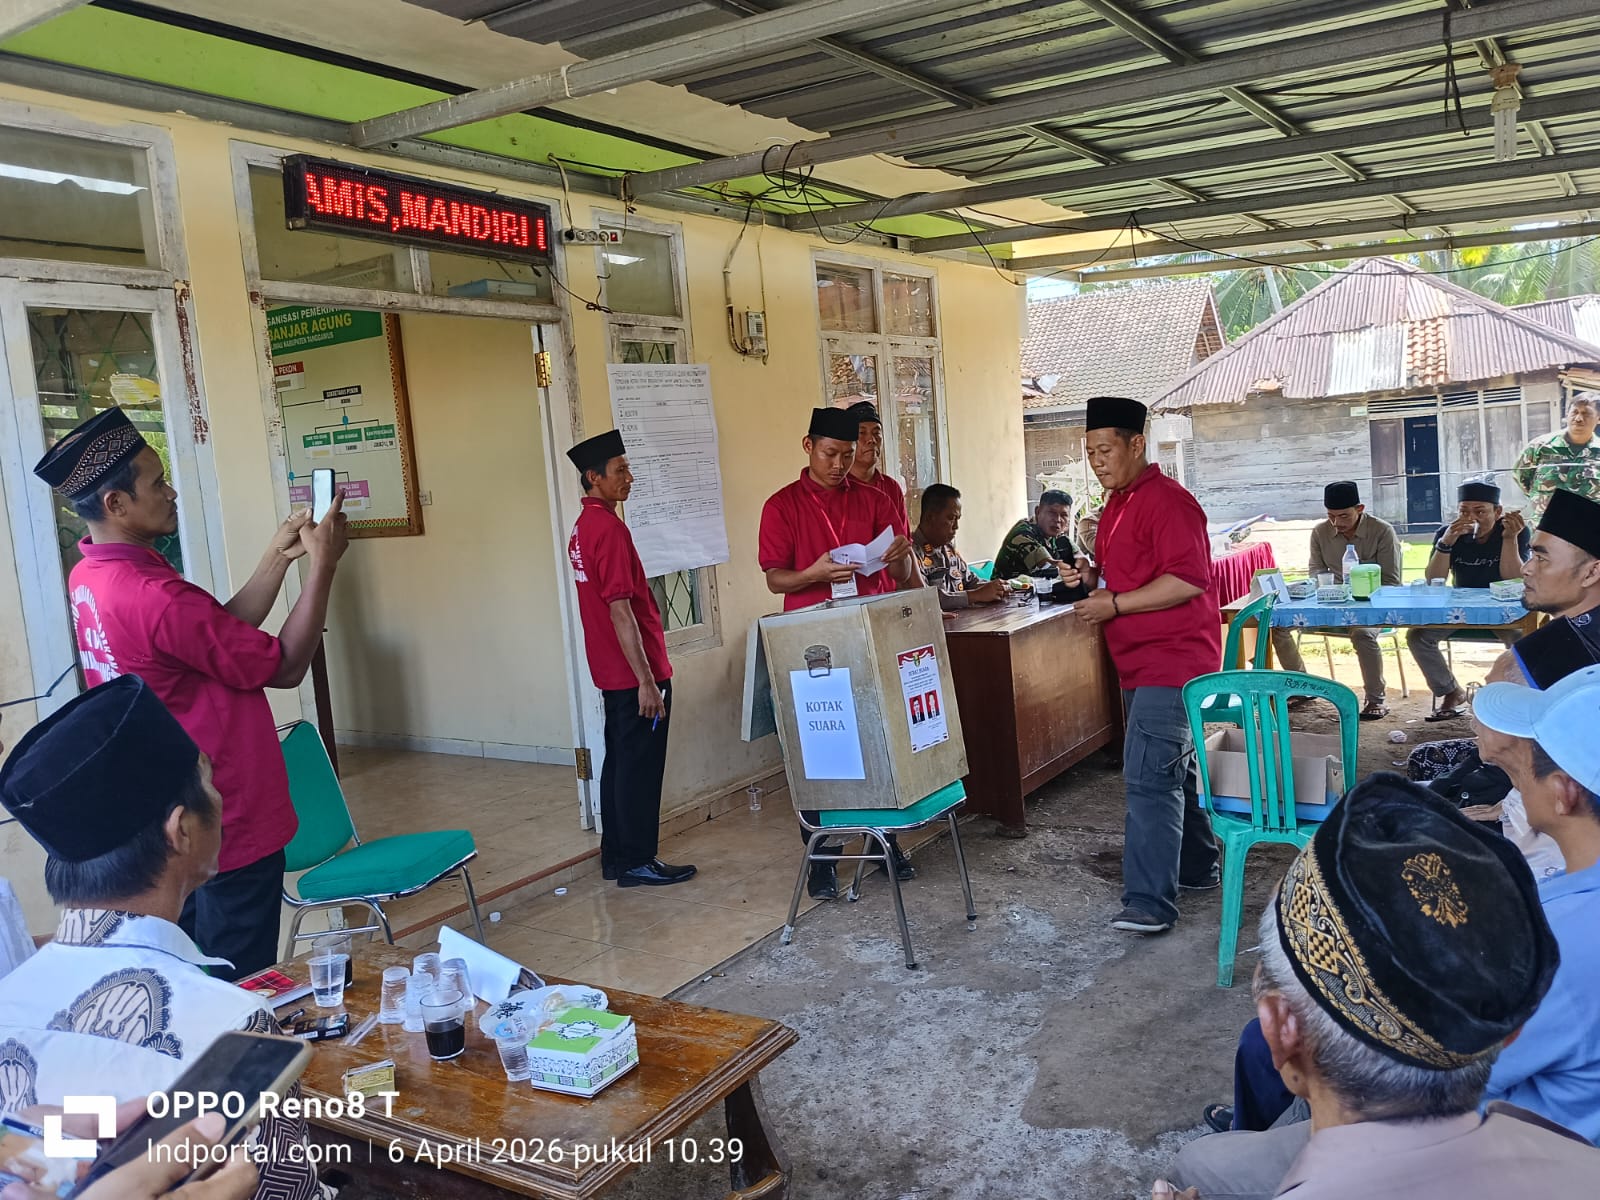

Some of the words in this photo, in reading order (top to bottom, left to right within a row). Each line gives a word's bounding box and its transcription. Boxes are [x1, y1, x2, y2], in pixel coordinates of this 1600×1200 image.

[312, 313, 352, 332] AGUNG
[279, 364, 297, 374] PEKON
[806, 701, 843, 713] KOTAK
[809, 720, 846, 731] SUARA
